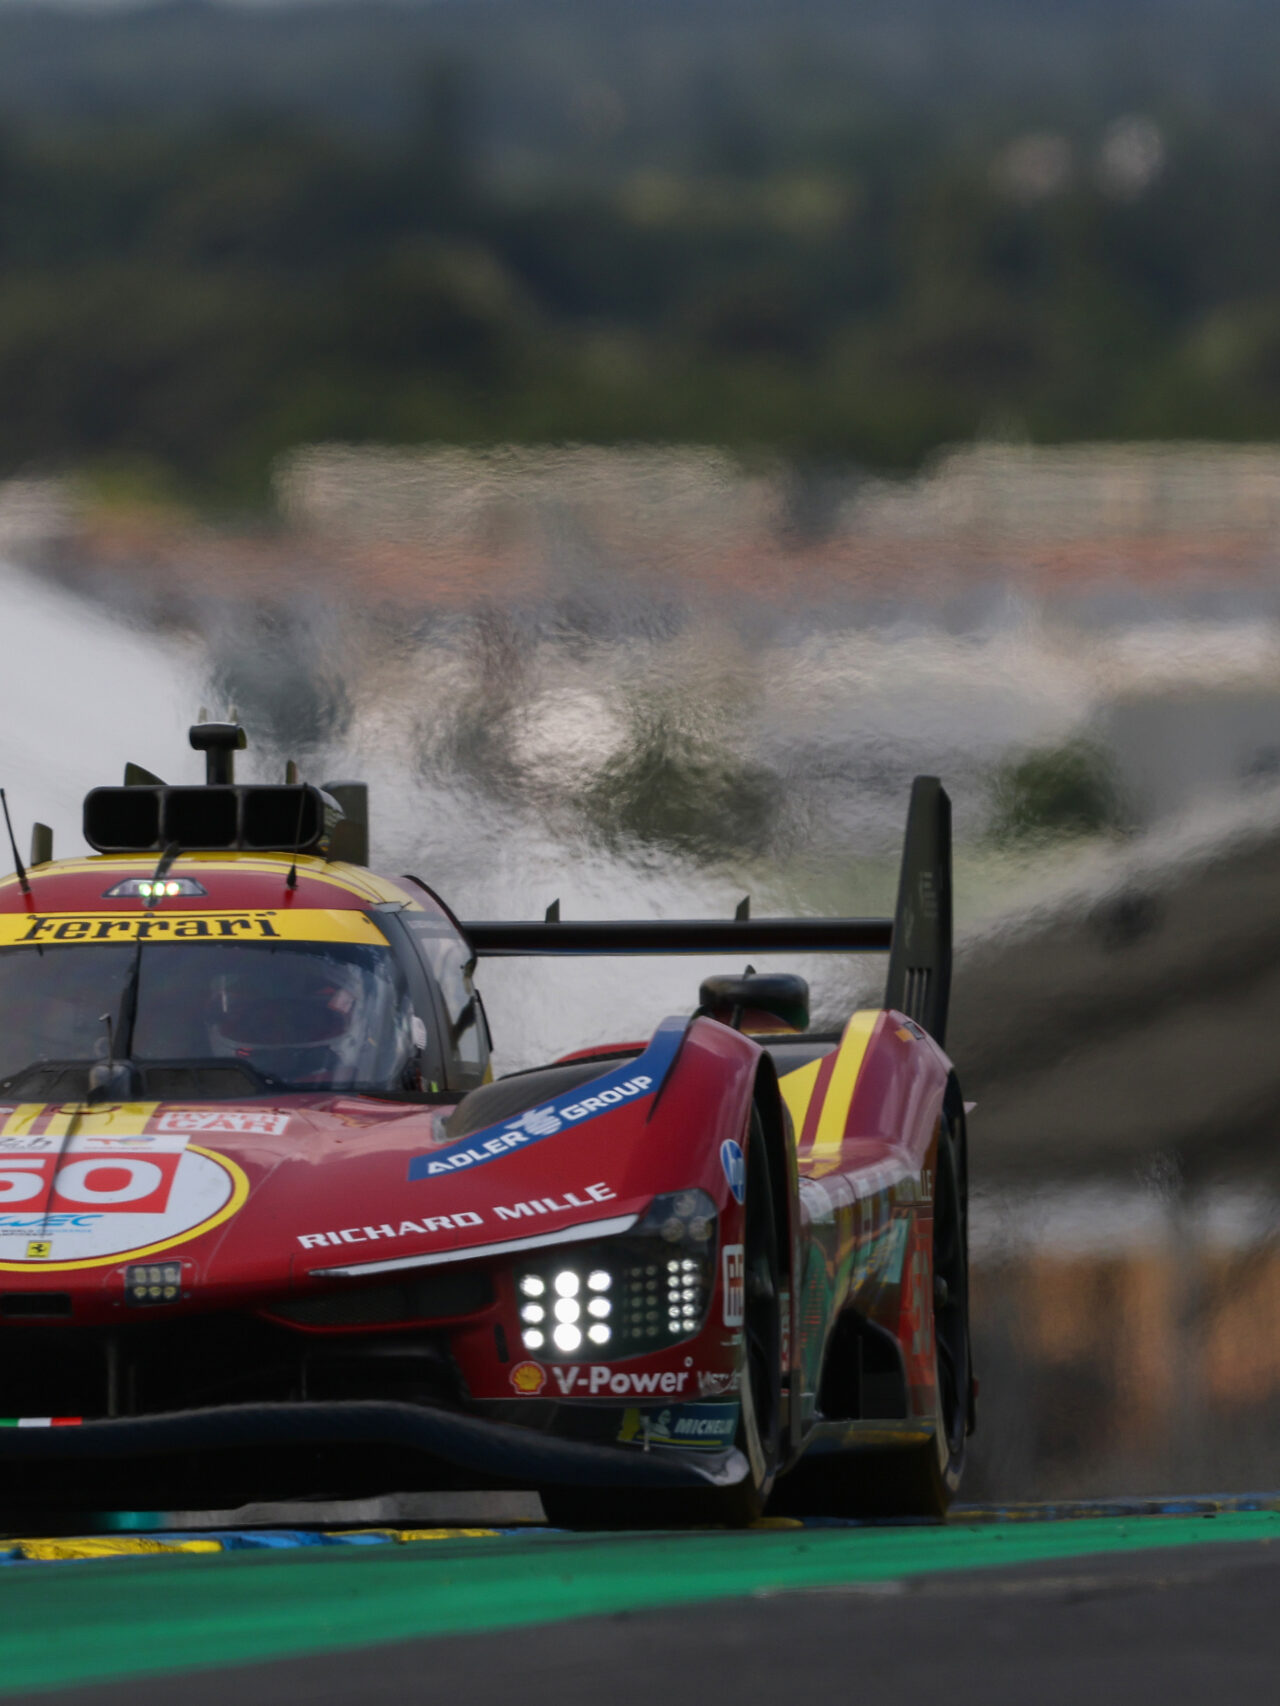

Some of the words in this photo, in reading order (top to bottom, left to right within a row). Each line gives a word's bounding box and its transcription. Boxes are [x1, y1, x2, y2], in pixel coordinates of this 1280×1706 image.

[15, 911, 280, 941] Ferrari
[167, 1119, 276, 1132] CAR
[427, 1130, 529, 1176] ADLER
[560, 1075, 653, 1122] GROUP
[296, 1210, 483, 1250] RICHARD
[493, 1181, 617, 1222] MILLE
[552, 1365, 688, 1395] V-Power
